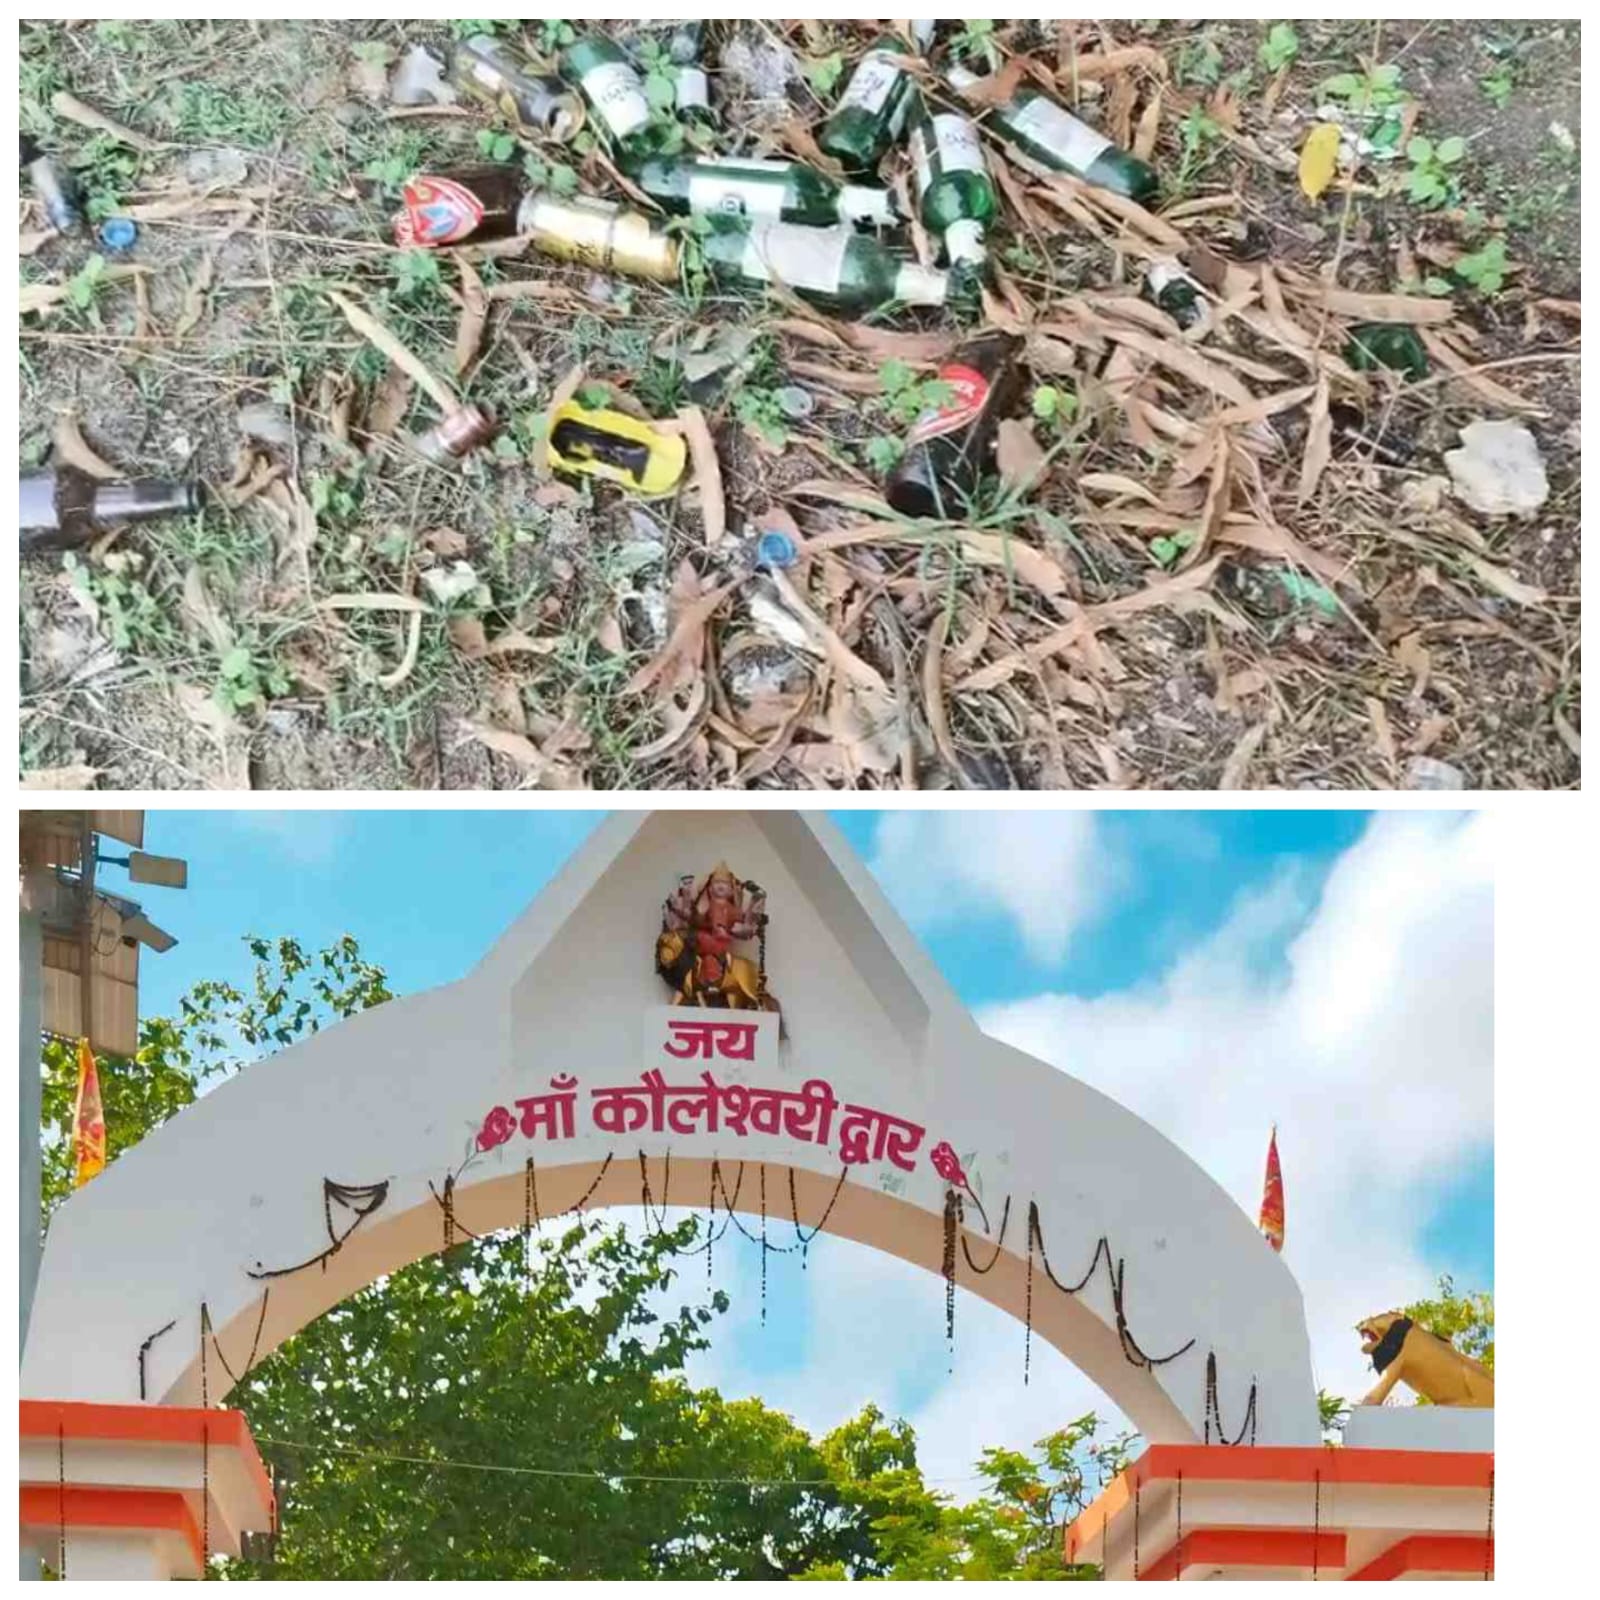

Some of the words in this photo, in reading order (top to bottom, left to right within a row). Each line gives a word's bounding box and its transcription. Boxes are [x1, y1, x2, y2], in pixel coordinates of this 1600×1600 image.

[664, 1020, 758, 1061] जय
[515, 1073, 578, 1140] माँ
[592, 1068, 838, 1146] कौलेश्वरी
[839, 1103, 926, 1172] द्वार
